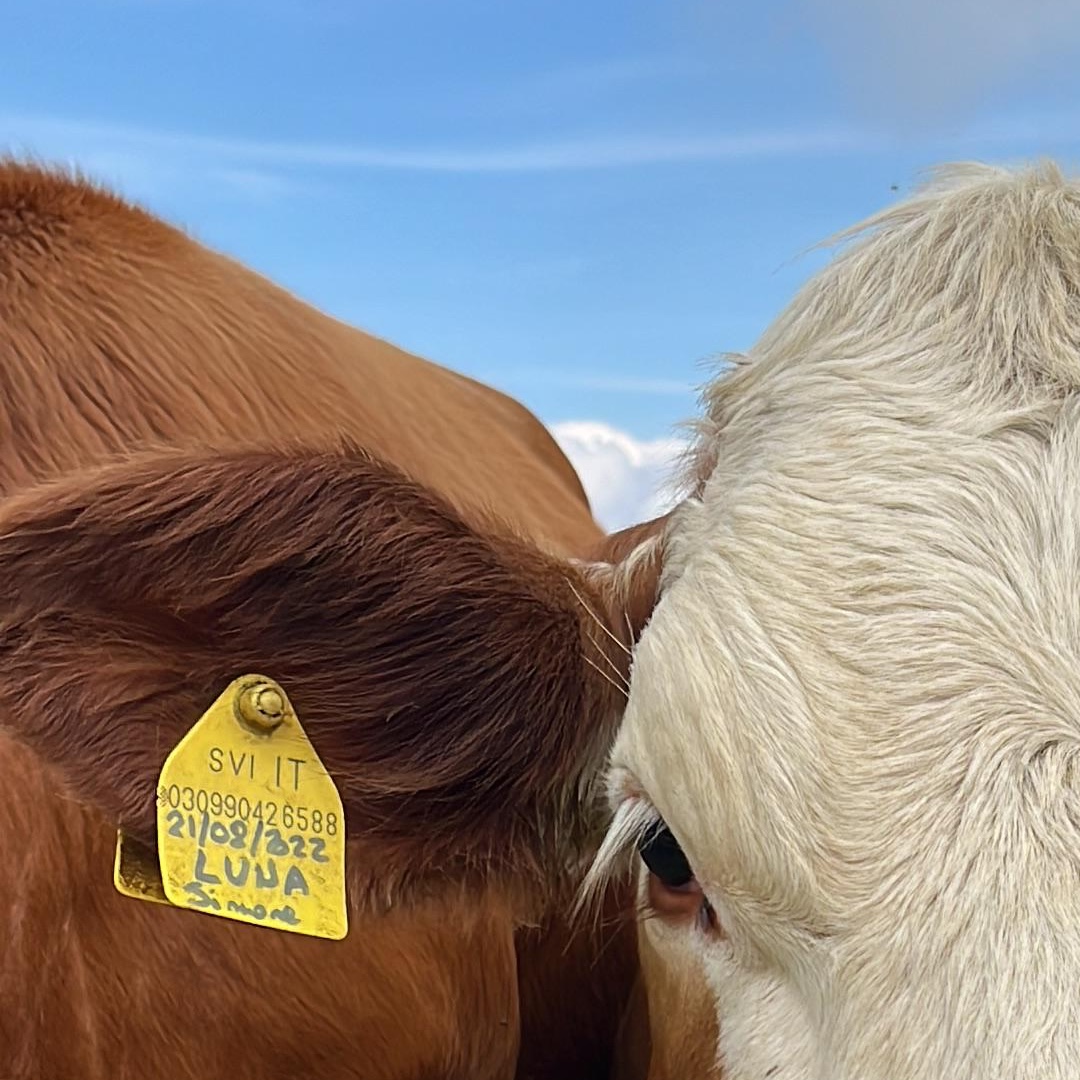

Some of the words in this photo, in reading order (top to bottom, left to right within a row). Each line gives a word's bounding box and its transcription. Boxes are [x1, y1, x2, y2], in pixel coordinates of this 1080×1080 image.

[209, 747, 255, 779] SVI
[276, 755, 307, 792] IT
[168, 784, 338, 836] 030990426588
[194, 848, 310, 897] LUNA
